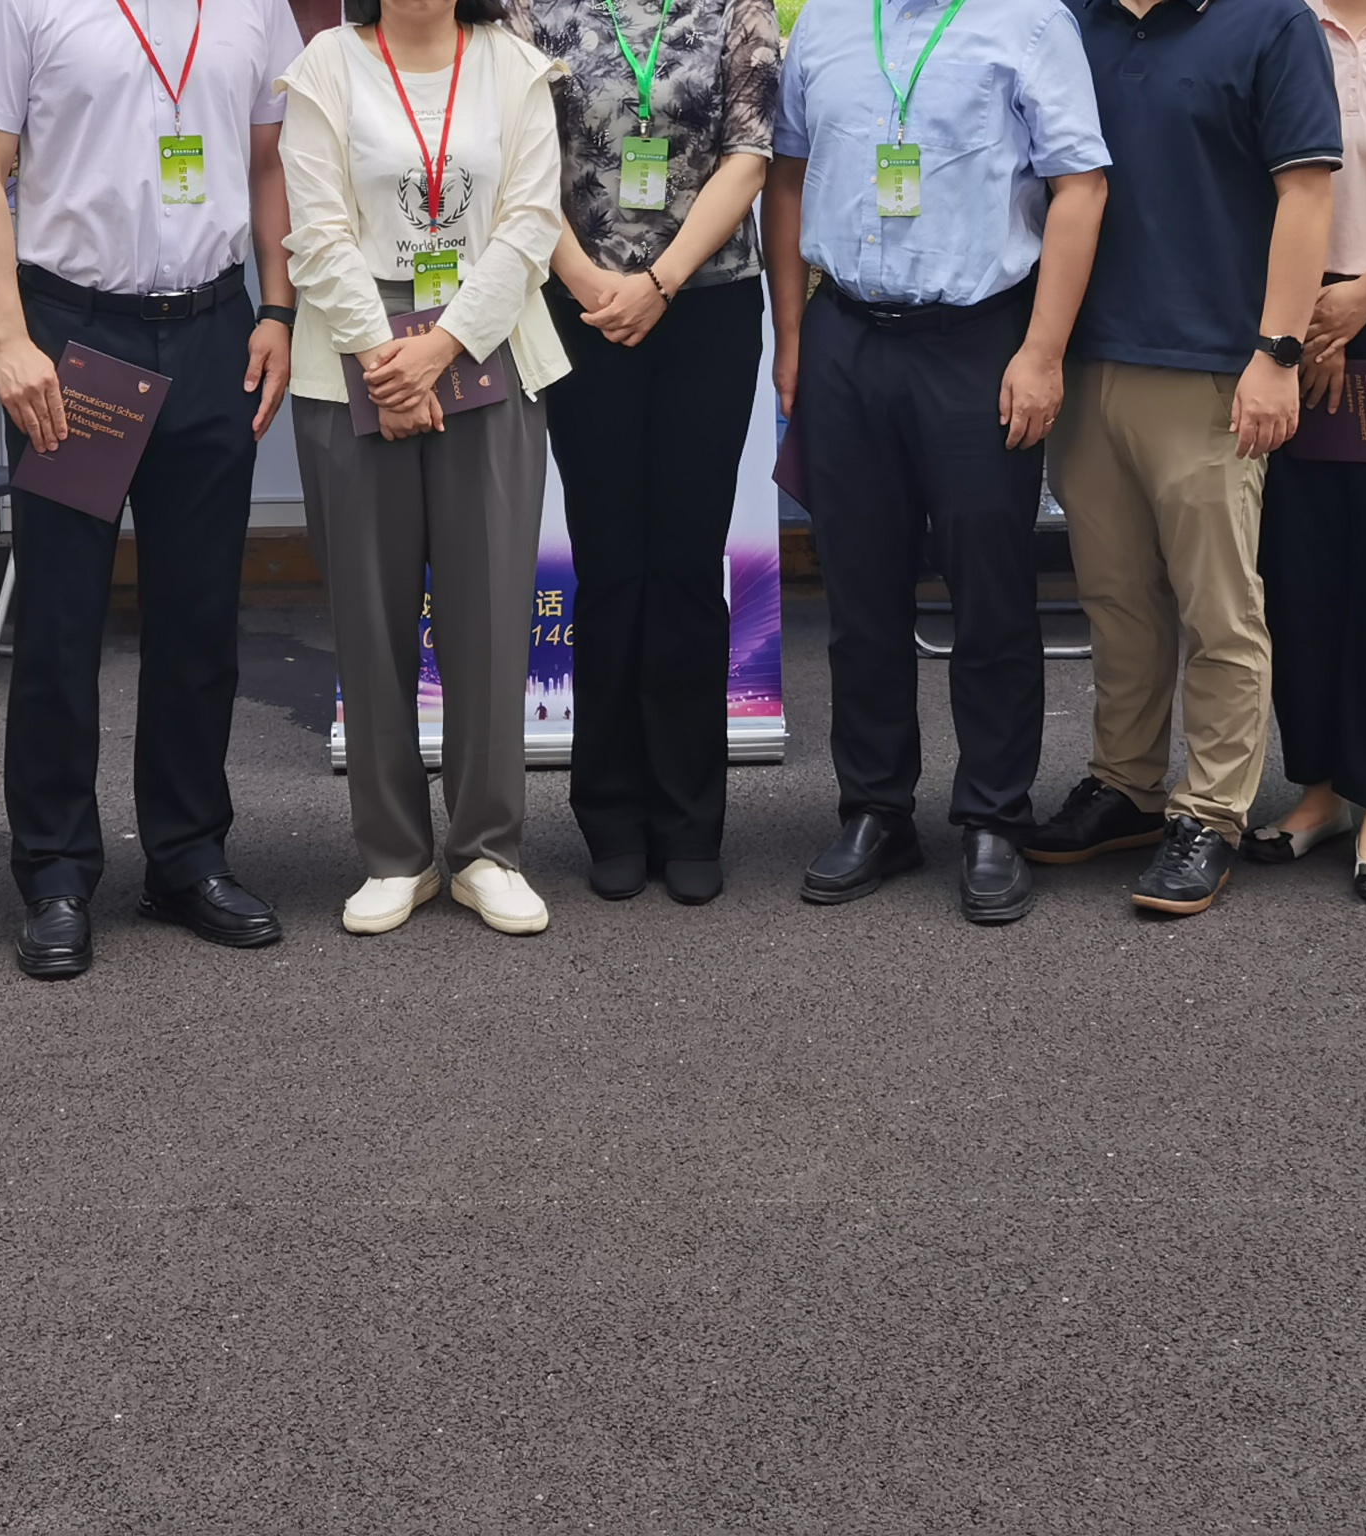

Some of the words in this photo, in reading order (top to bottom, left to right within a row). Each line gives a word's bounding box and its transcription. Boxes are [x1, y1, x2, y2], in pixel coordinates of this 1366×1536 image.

[396, 239, 433, 252] World
[437, 236, 466, 249] Food
[116, 405, 145, 422] School
[536, 590, 563, 616] 话
